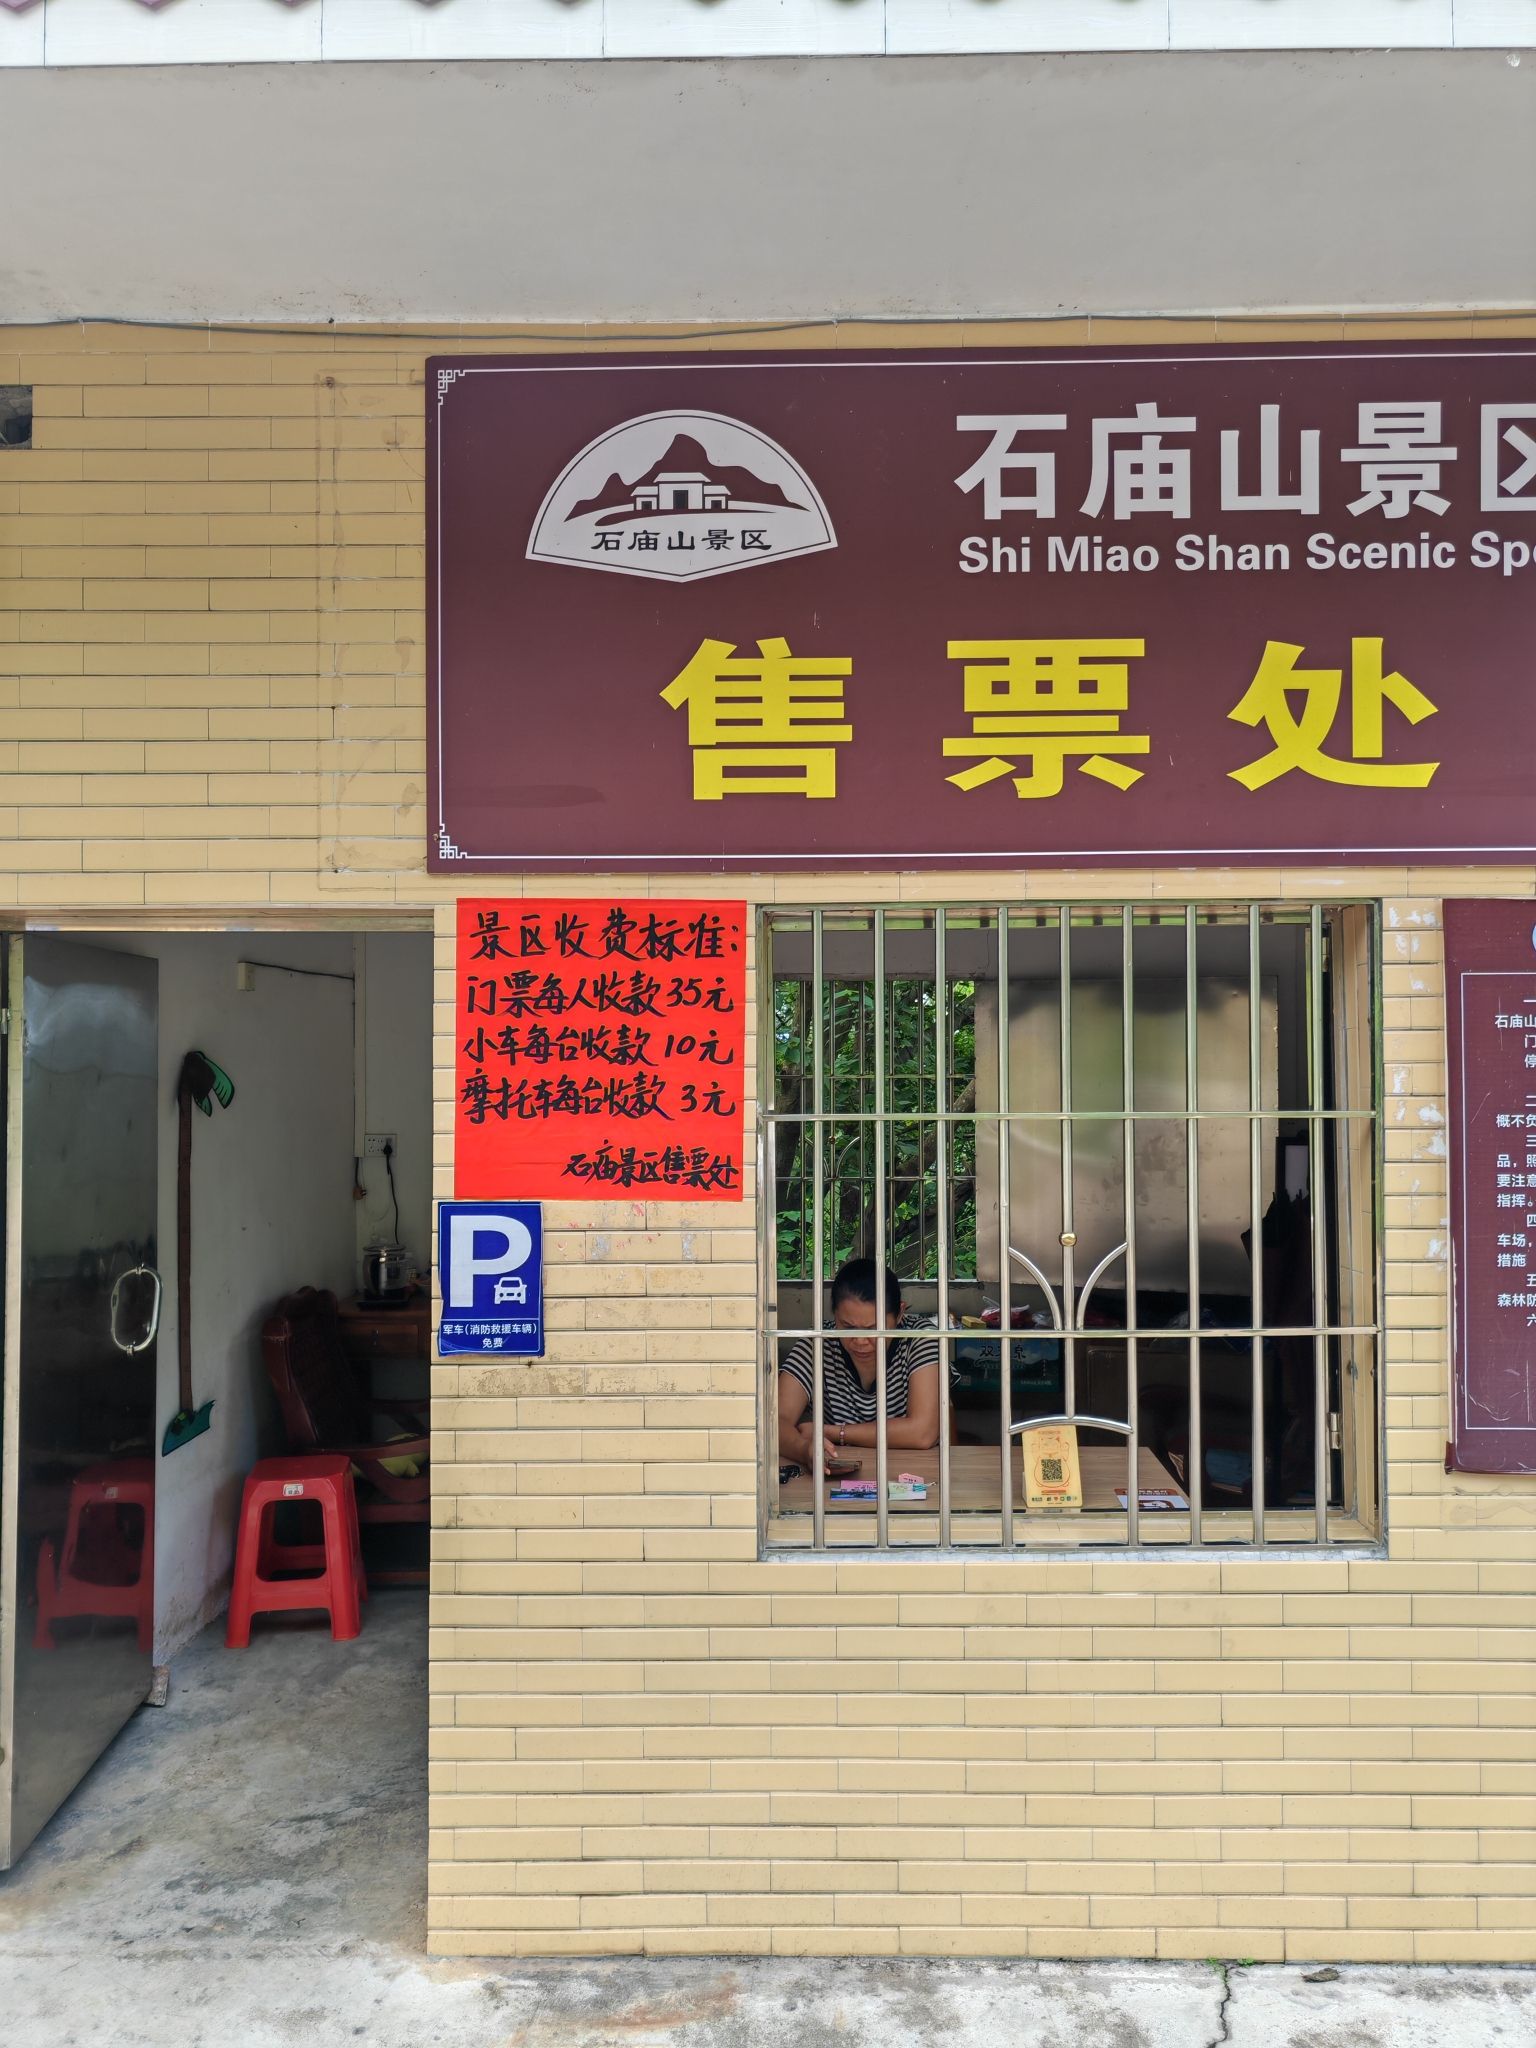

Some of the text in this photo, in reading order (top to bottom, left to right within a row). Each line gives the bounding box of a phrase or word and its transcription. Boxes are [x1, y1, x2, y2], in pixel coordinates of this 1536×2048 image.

[590, 529, 772, 552] 石庙山景区
[959, 530, 1536, 577] Shi Miao Shan Scenic Sp
[659, 636, 1441, 800] 售票处
[1494, 1014, 1536, 1029] 石庙山
[561, 1140, 739, 1191] 石庙景区售票处
[450, 1215, 533, 1308] P
[1497, 1254, 1526, 1267] 措施
[482, 1337, 503, 1348] 免费
